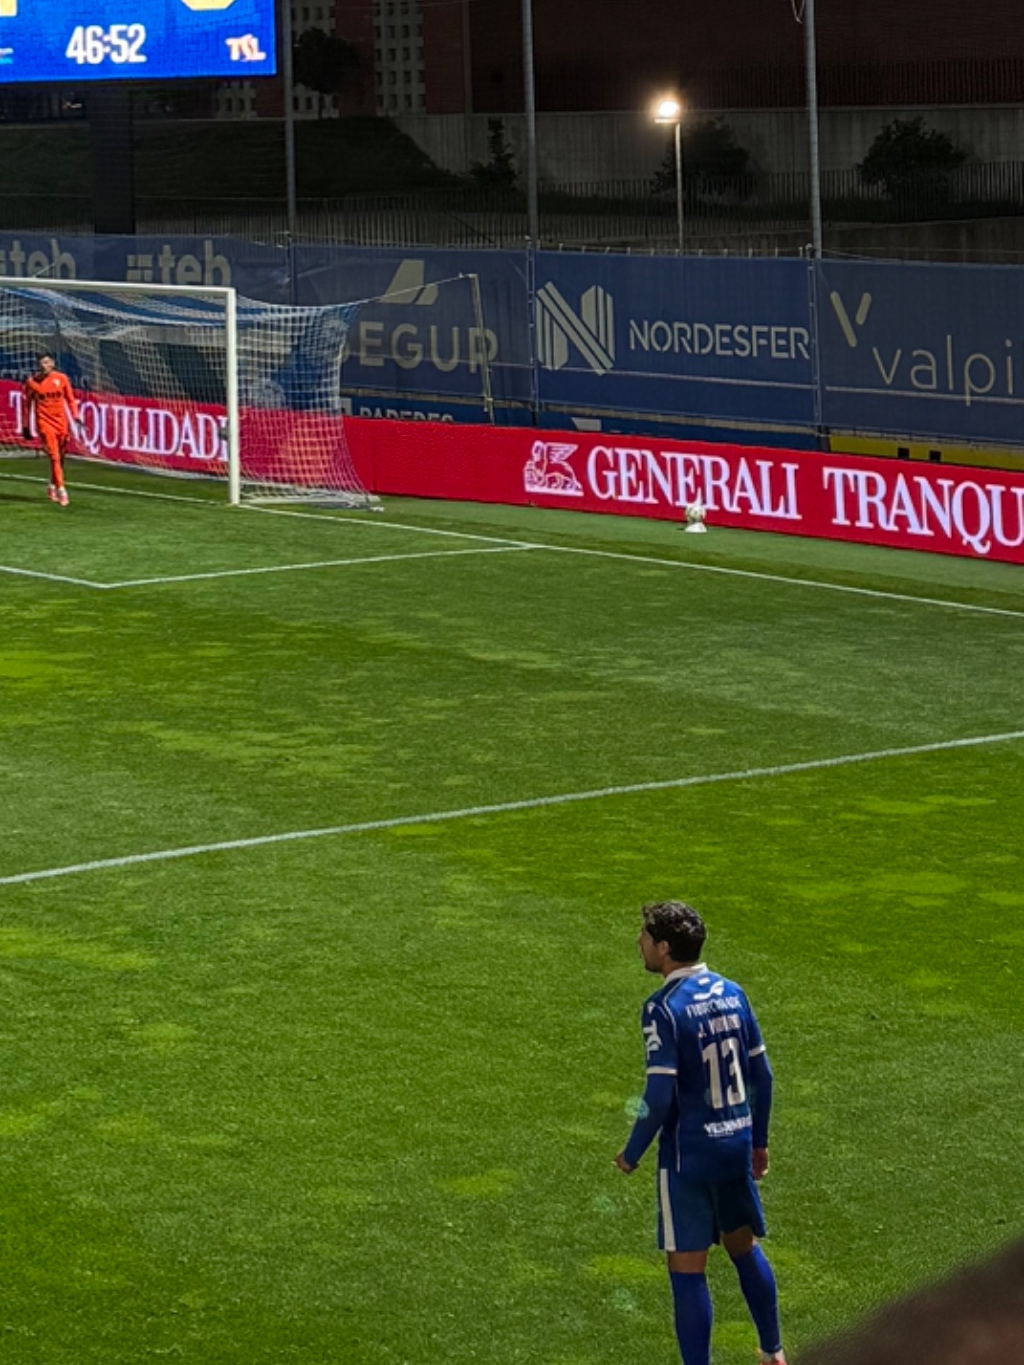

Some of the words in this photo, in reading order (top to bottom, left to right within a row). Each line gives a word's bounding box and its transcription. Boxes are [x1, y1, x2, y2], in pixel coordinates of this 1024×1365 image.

[65, 23, 147, 65] 46:52
[340, 321, 499, 374] EGUP
[629, 319, 811, 360] NORDESFER
[872, 334, 1014, 407] valpi
[587, 445, 803, 521] GENERALI
[823, 466, 1024, 554] TRANQU
[702, 1037, 746, 1110] 13
